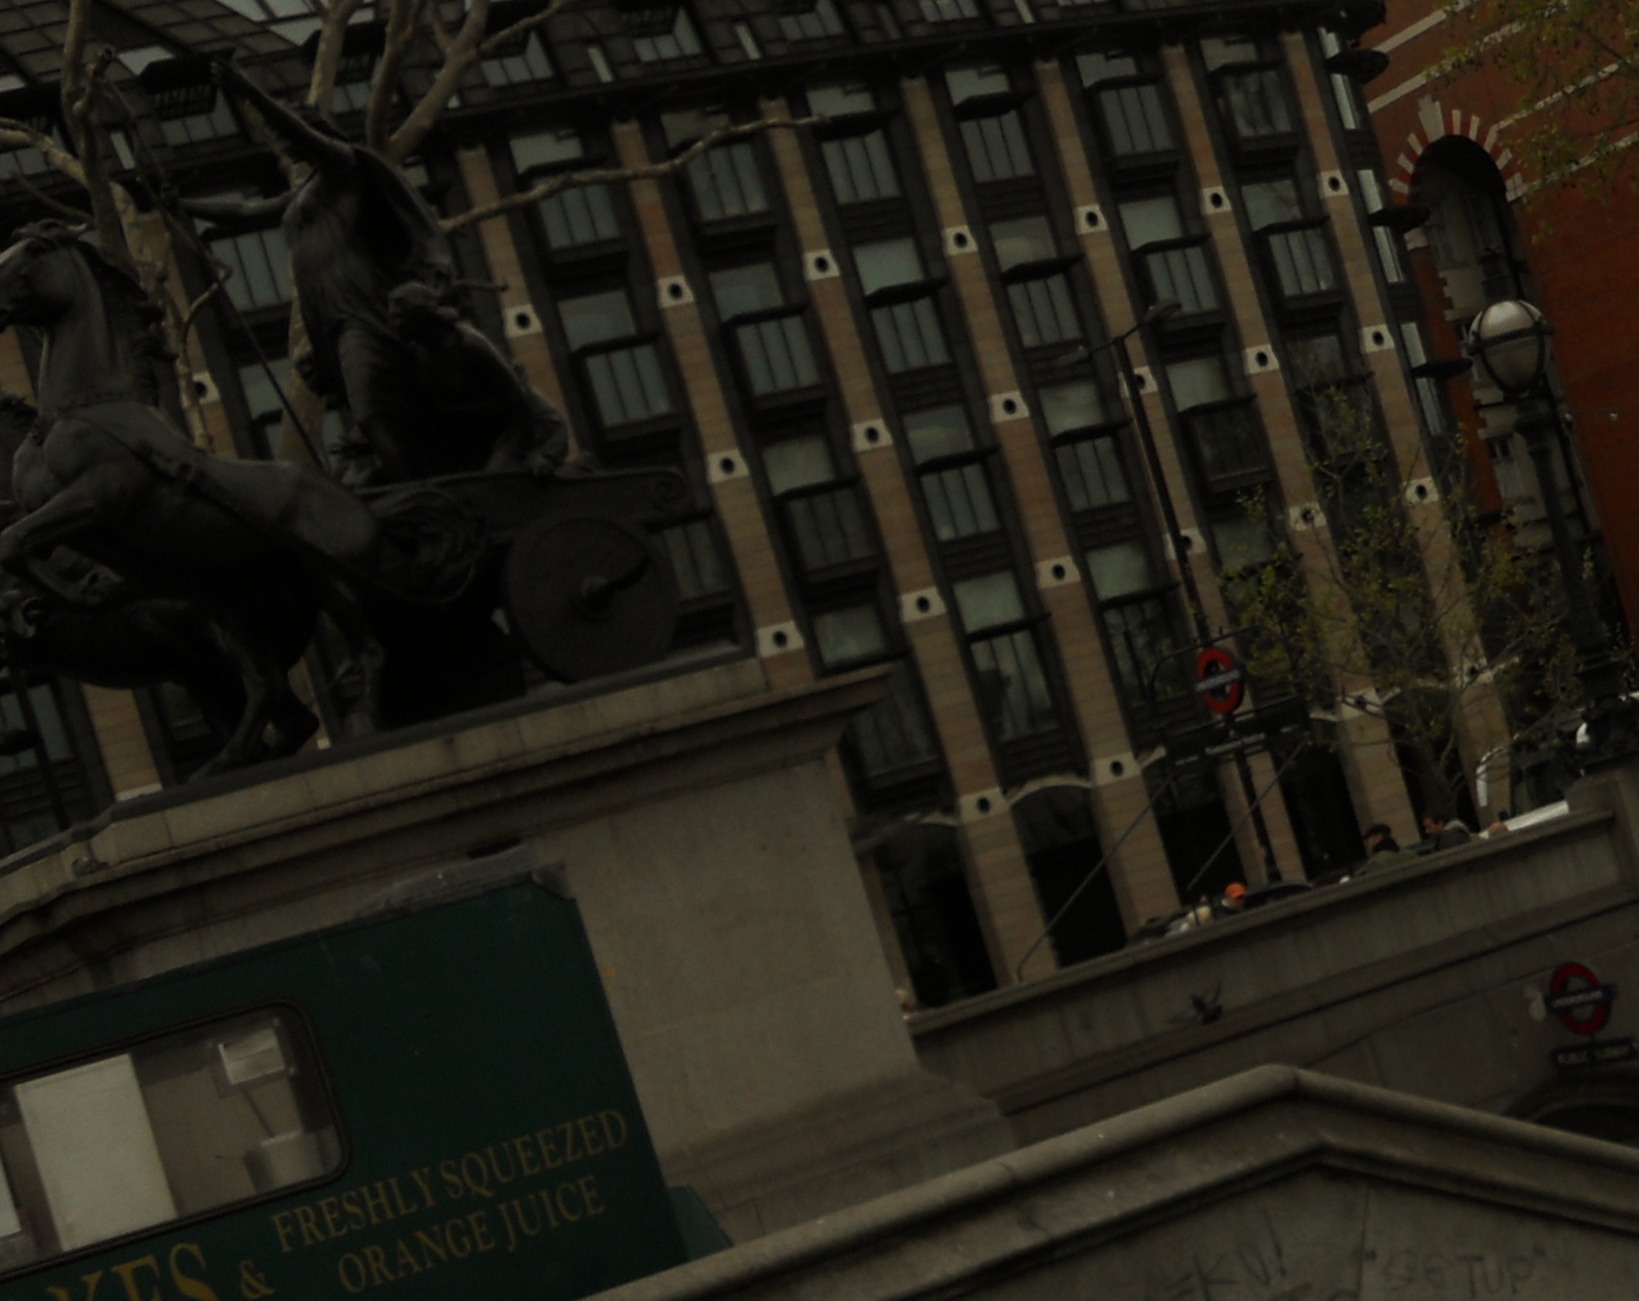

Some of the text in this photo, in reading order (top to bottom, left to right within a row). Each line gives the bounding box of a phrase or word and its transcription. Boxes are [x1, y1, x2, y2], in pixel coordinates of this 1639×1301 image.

[271, 1108, 631, 1255] FRESHLY SQUEEZED
[336, 1174, 606, 1294] ORANGE JUICE
[238, 1259, 275, 1300] &
